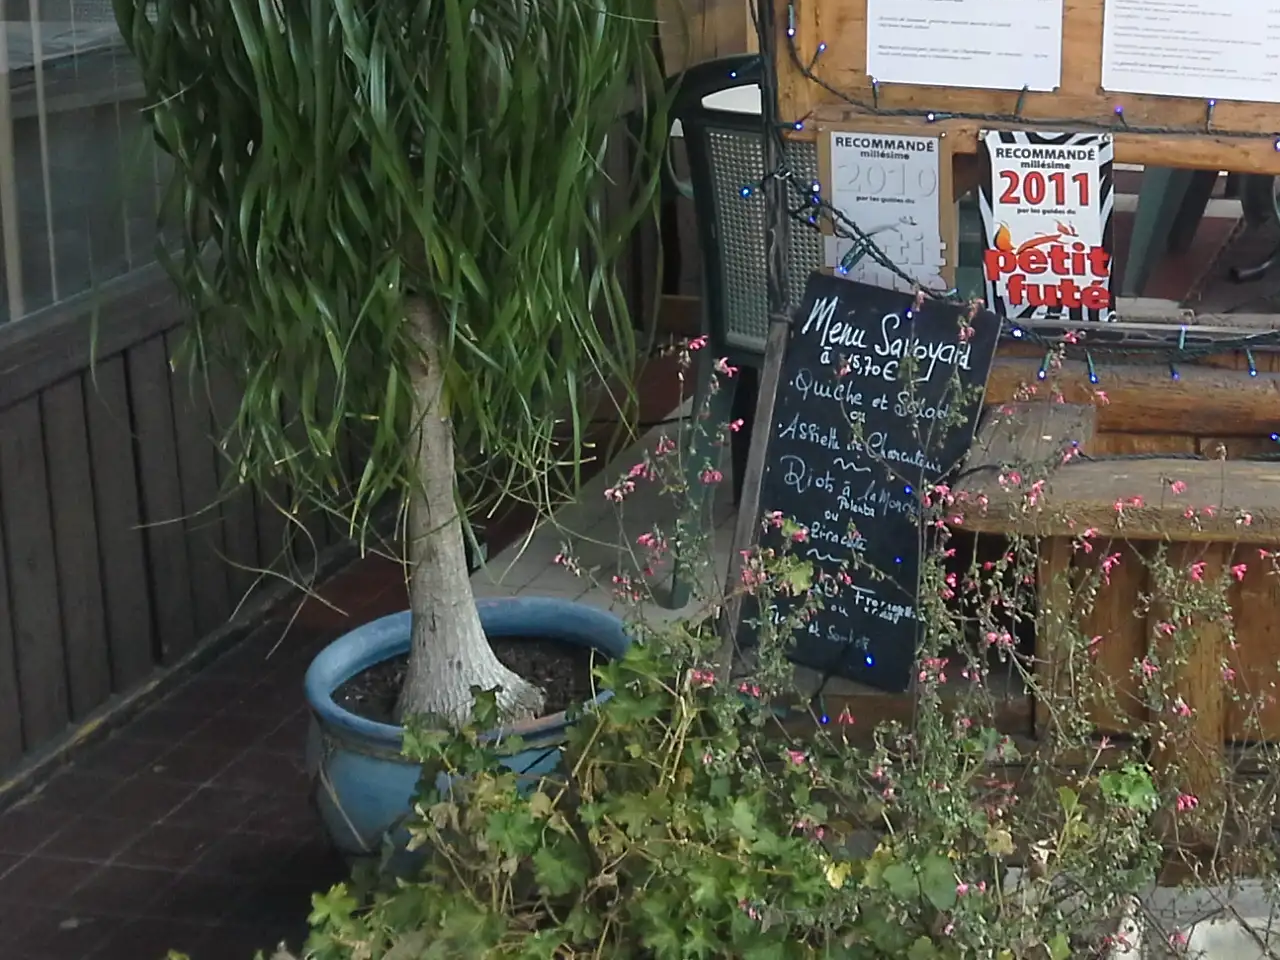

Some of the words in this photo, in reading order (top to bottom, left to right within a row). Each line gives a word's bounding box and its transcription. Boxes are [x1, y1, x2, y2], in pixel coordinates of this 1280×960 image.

[836, 136, 934, 152] RECOMMANDÉ
[860, 150, 910, 160] millésime
[996, 148, 1095, 160] RECOMMANDÉ
[1020, 160, 1071, 169] millésime
[999, 170, 1089, 206] 2011
[984, 241, 1111, 281] petit
[1006, 274, 1111, 309] futé
[801, 296, 867, 346] Menu
[874, 313, 971, 382] Savoyard
